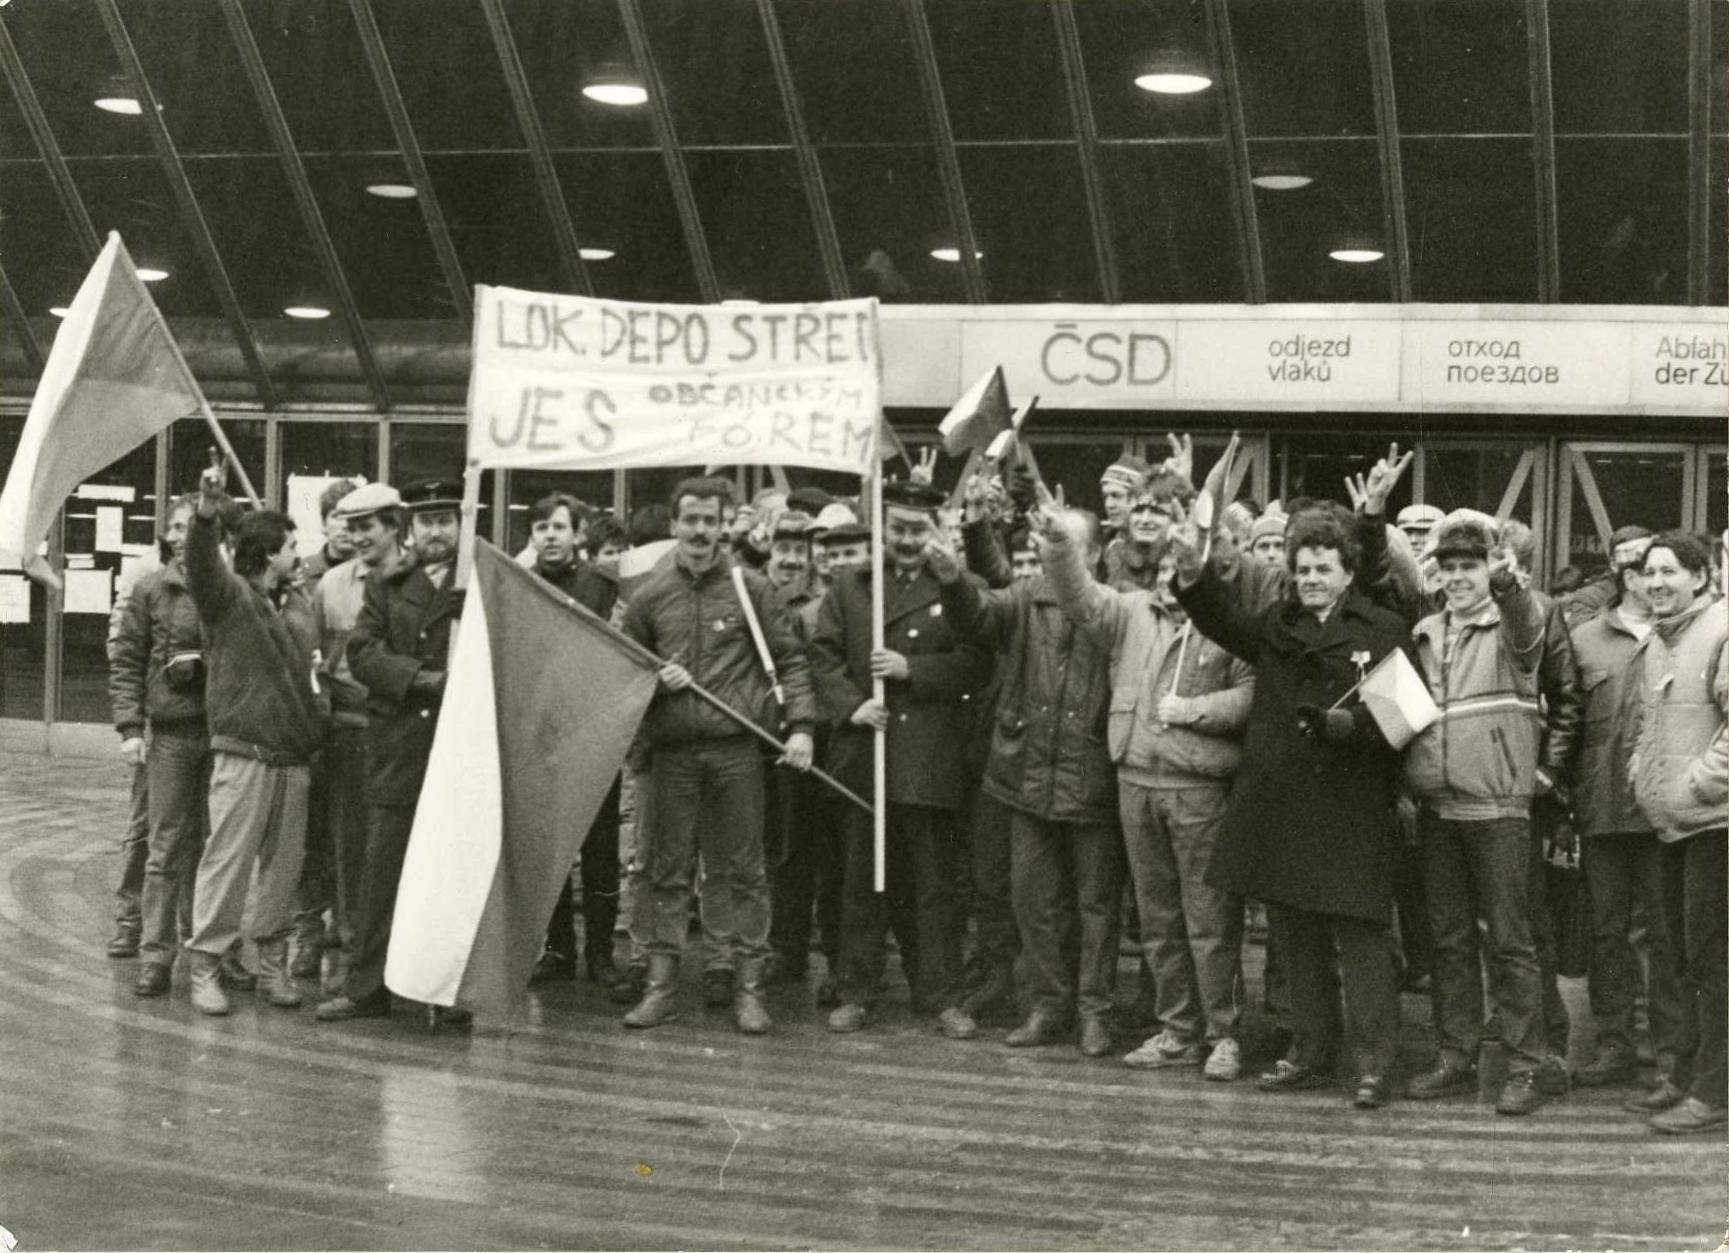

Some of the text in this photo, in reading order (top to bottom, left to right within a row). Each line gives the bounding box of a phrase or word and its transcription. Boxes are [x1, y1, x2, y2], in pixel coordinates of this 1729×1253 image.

[497, 301, 589, 356] LOK.
[600, 306, 711, 365] DEPO
[1268, 334, 1351, 361] odjezd
[1448, 339, 1521, 359] отход
[1267, 359, 1332, 382] vlaků
[1447, 364, 1560, 385] поездов
[1655, 361, 1700, 385] der
